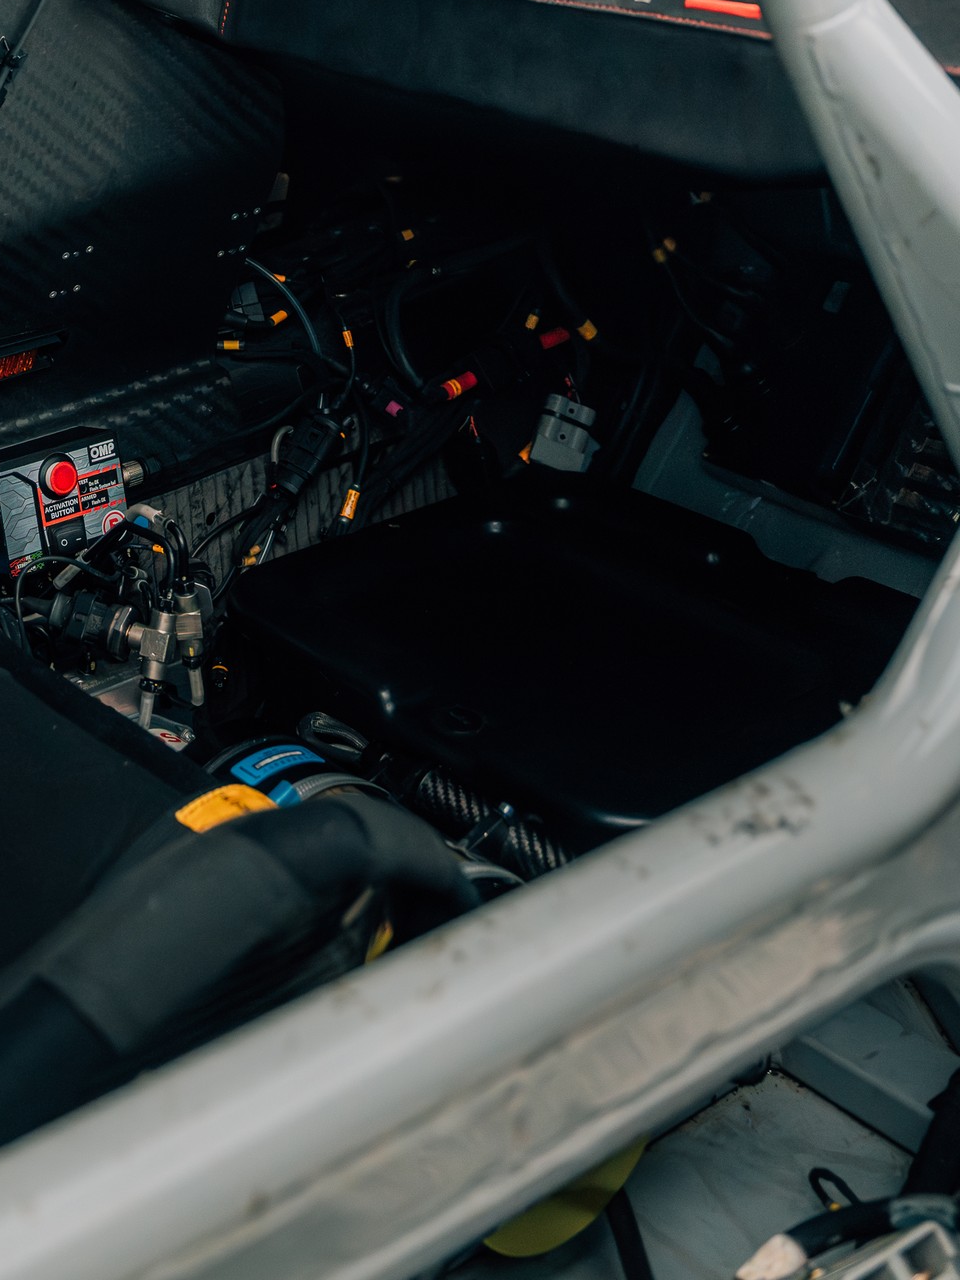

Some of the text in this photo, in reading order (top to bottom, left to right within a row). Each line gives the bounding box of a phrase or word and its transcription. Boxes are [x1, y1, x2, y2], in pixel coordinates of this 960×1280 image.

[90, 442, 115, 459] OMP
[81, 494, 97, 502] ARMED
[45, 498, 78, 514] ACTIVATION
[50, 506, 74, 520] BUTTON
